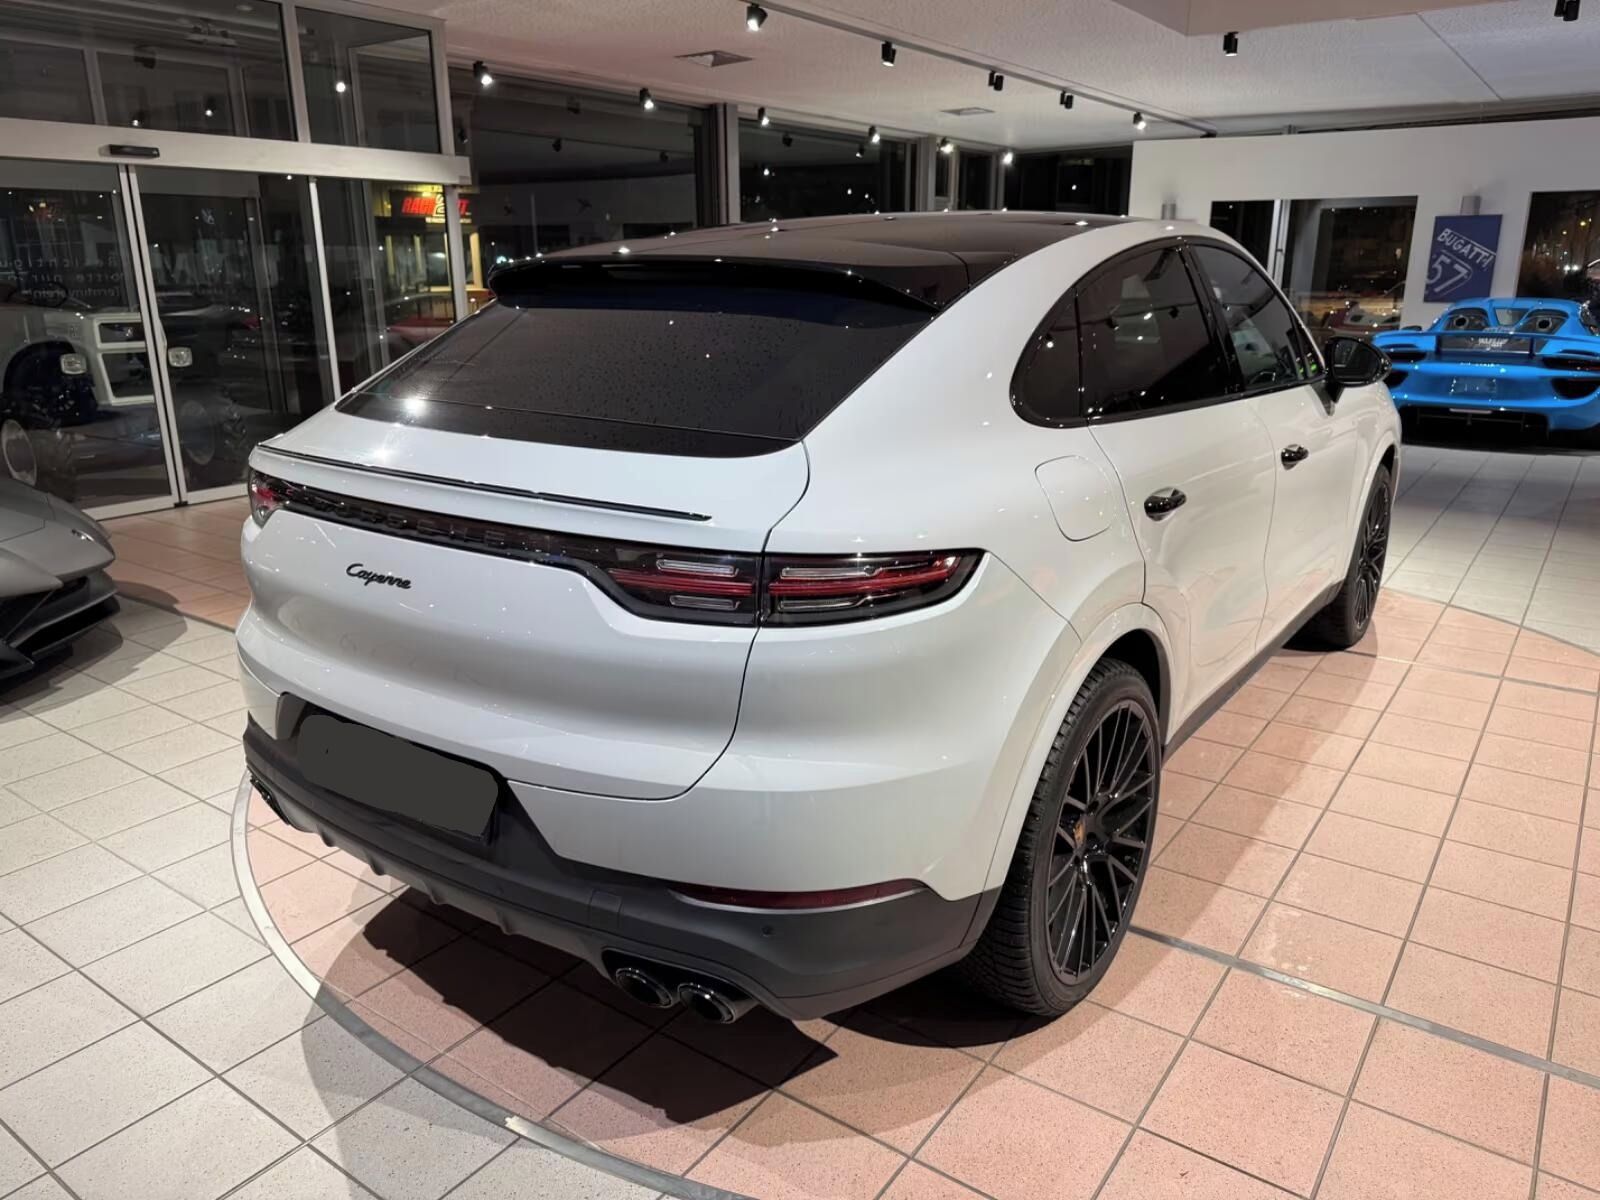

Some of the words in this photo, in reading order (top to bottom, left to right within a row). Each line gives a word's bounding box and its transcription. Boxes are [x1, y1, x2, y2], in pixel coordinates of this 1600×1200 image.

[1437, 228, 1494, 267] BUGATTI
[1426, 255, 1468, 292] 57
[346, 563, 411, 589] Cayenne
